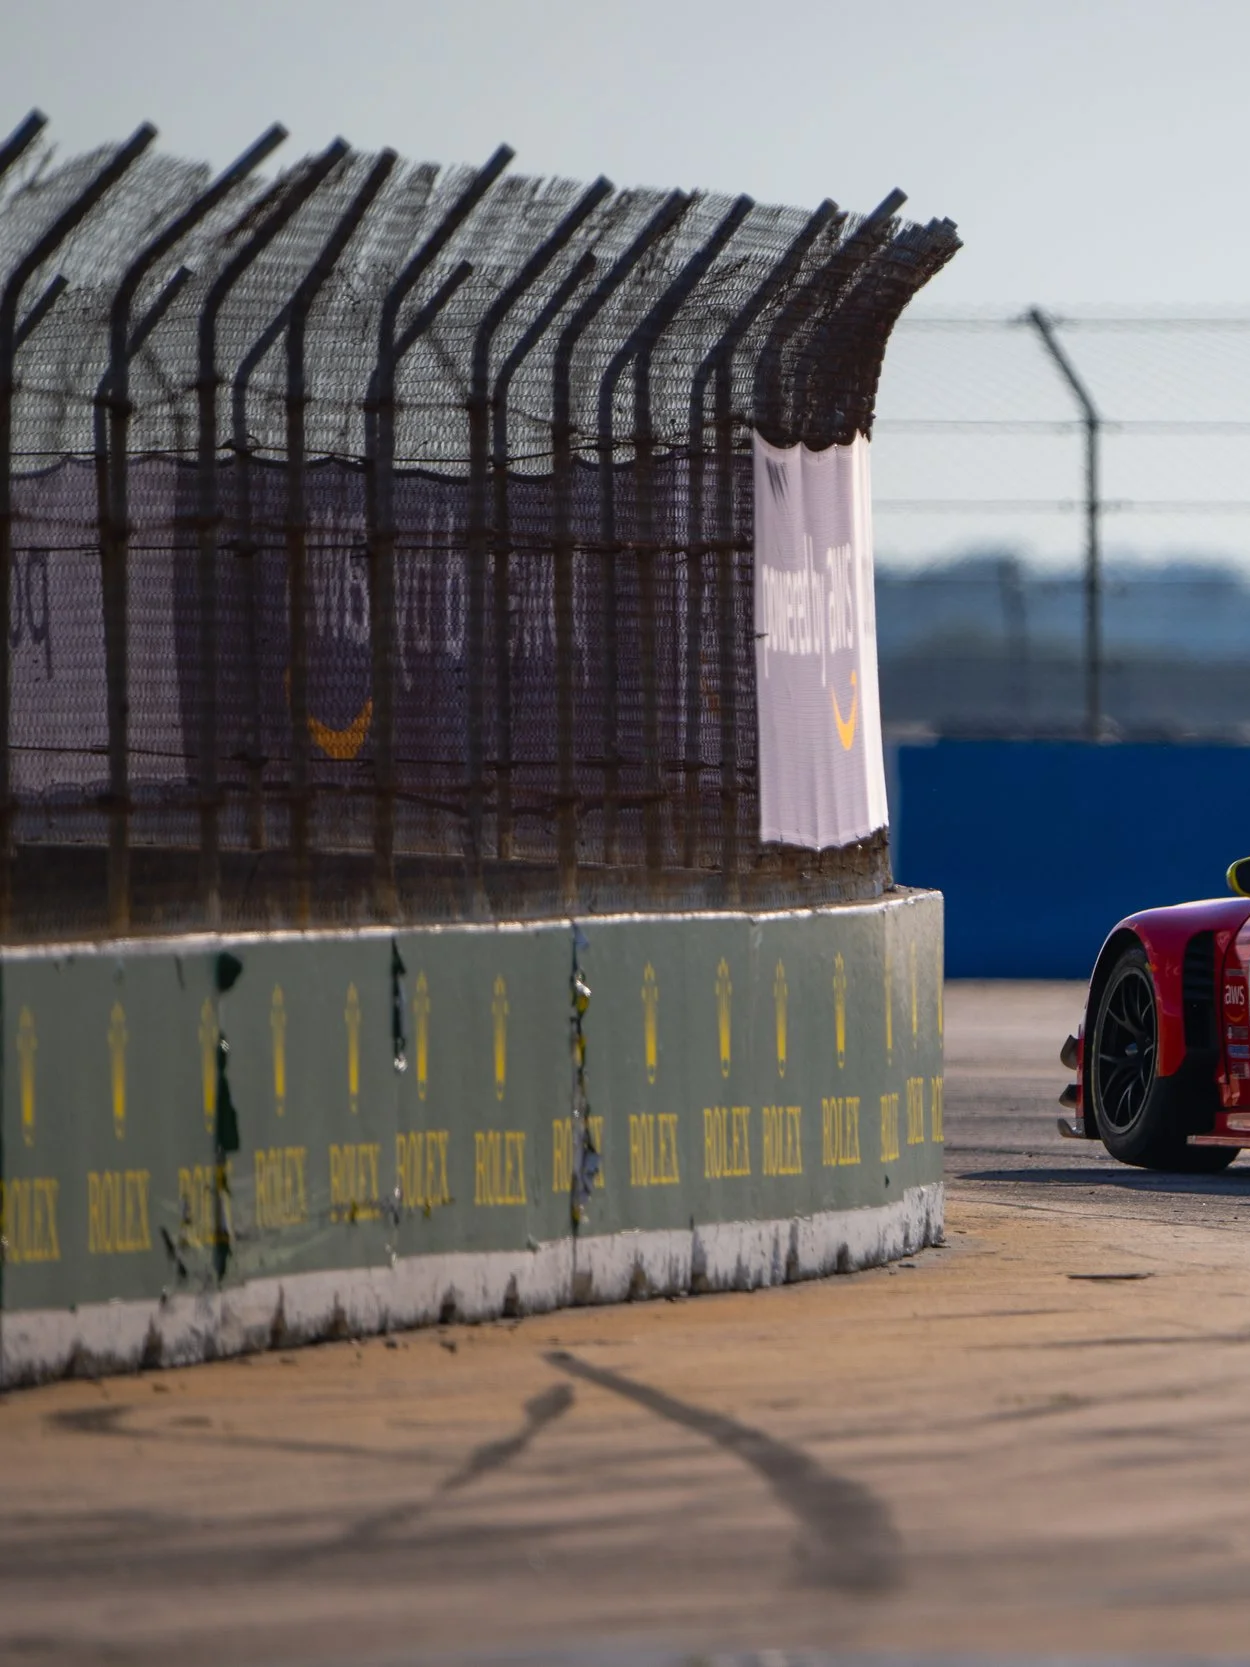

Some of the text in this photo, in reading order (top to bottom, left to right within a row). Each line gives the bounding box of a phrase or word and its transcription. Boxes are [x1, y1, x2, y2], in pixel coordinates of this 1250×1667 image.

[1225, 985, 1245, 1005] aws
[553, 1118, 604, 1191] ROX
[629, 1113, 680, 1186] ROLEX
[703, 1107, 751, 1178] ROLEX
[762, 1107, 803, 1175] ROLEX
[822, 1097, 861, 1165] ROLEX
[255, 1148, 307, 1226] ROLEX
[396, 1132, 448, 1207] ROLEX
[475, 1131, 526, 1205] ROLEX
[88, 1170, 151, 1253] ROLEX
